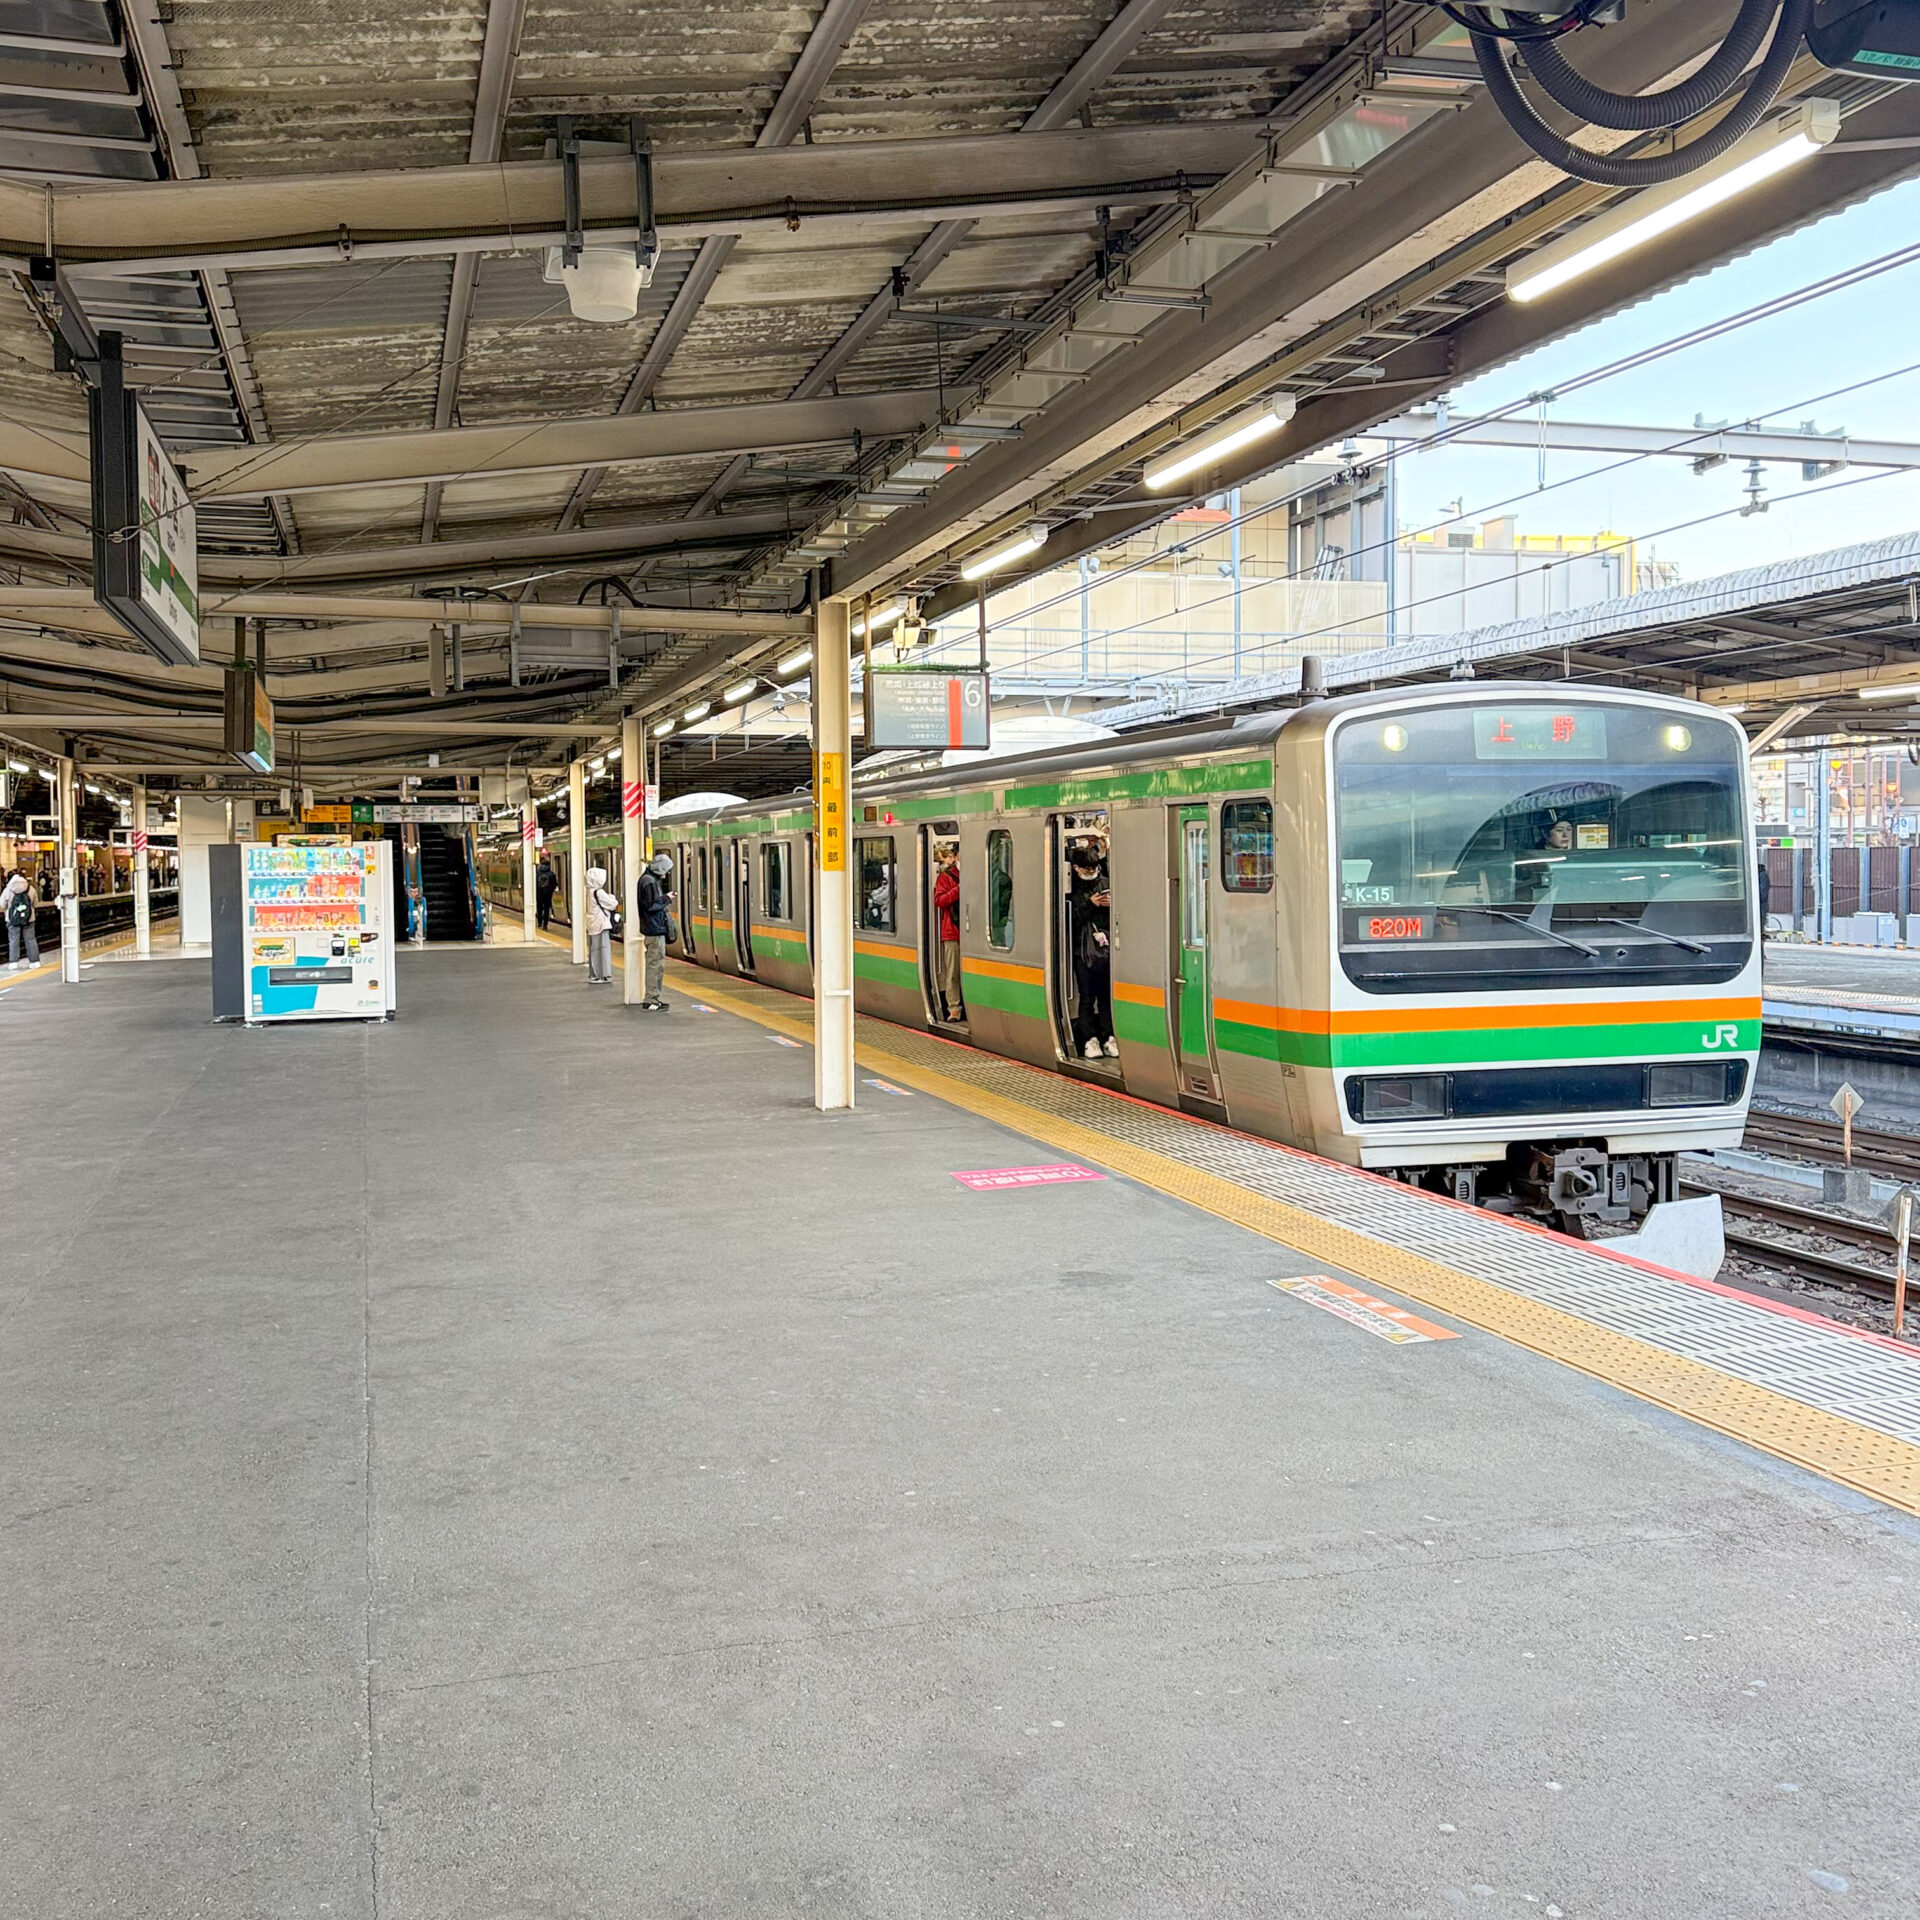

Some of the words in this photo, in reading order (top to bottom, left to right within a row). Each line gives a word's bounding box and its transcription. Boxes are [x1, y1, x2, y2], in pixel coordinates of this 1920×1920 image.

[964, 679, 982, 707] 6
[1490, 715, 1577, 743] 上野
[1522, 742, 1546, 751] Ueno
[1355, 887, 1390, 902] K-15
[1369, 917, 1422, 938] 820M
[1702, 1024, 1739, 1049] JR
